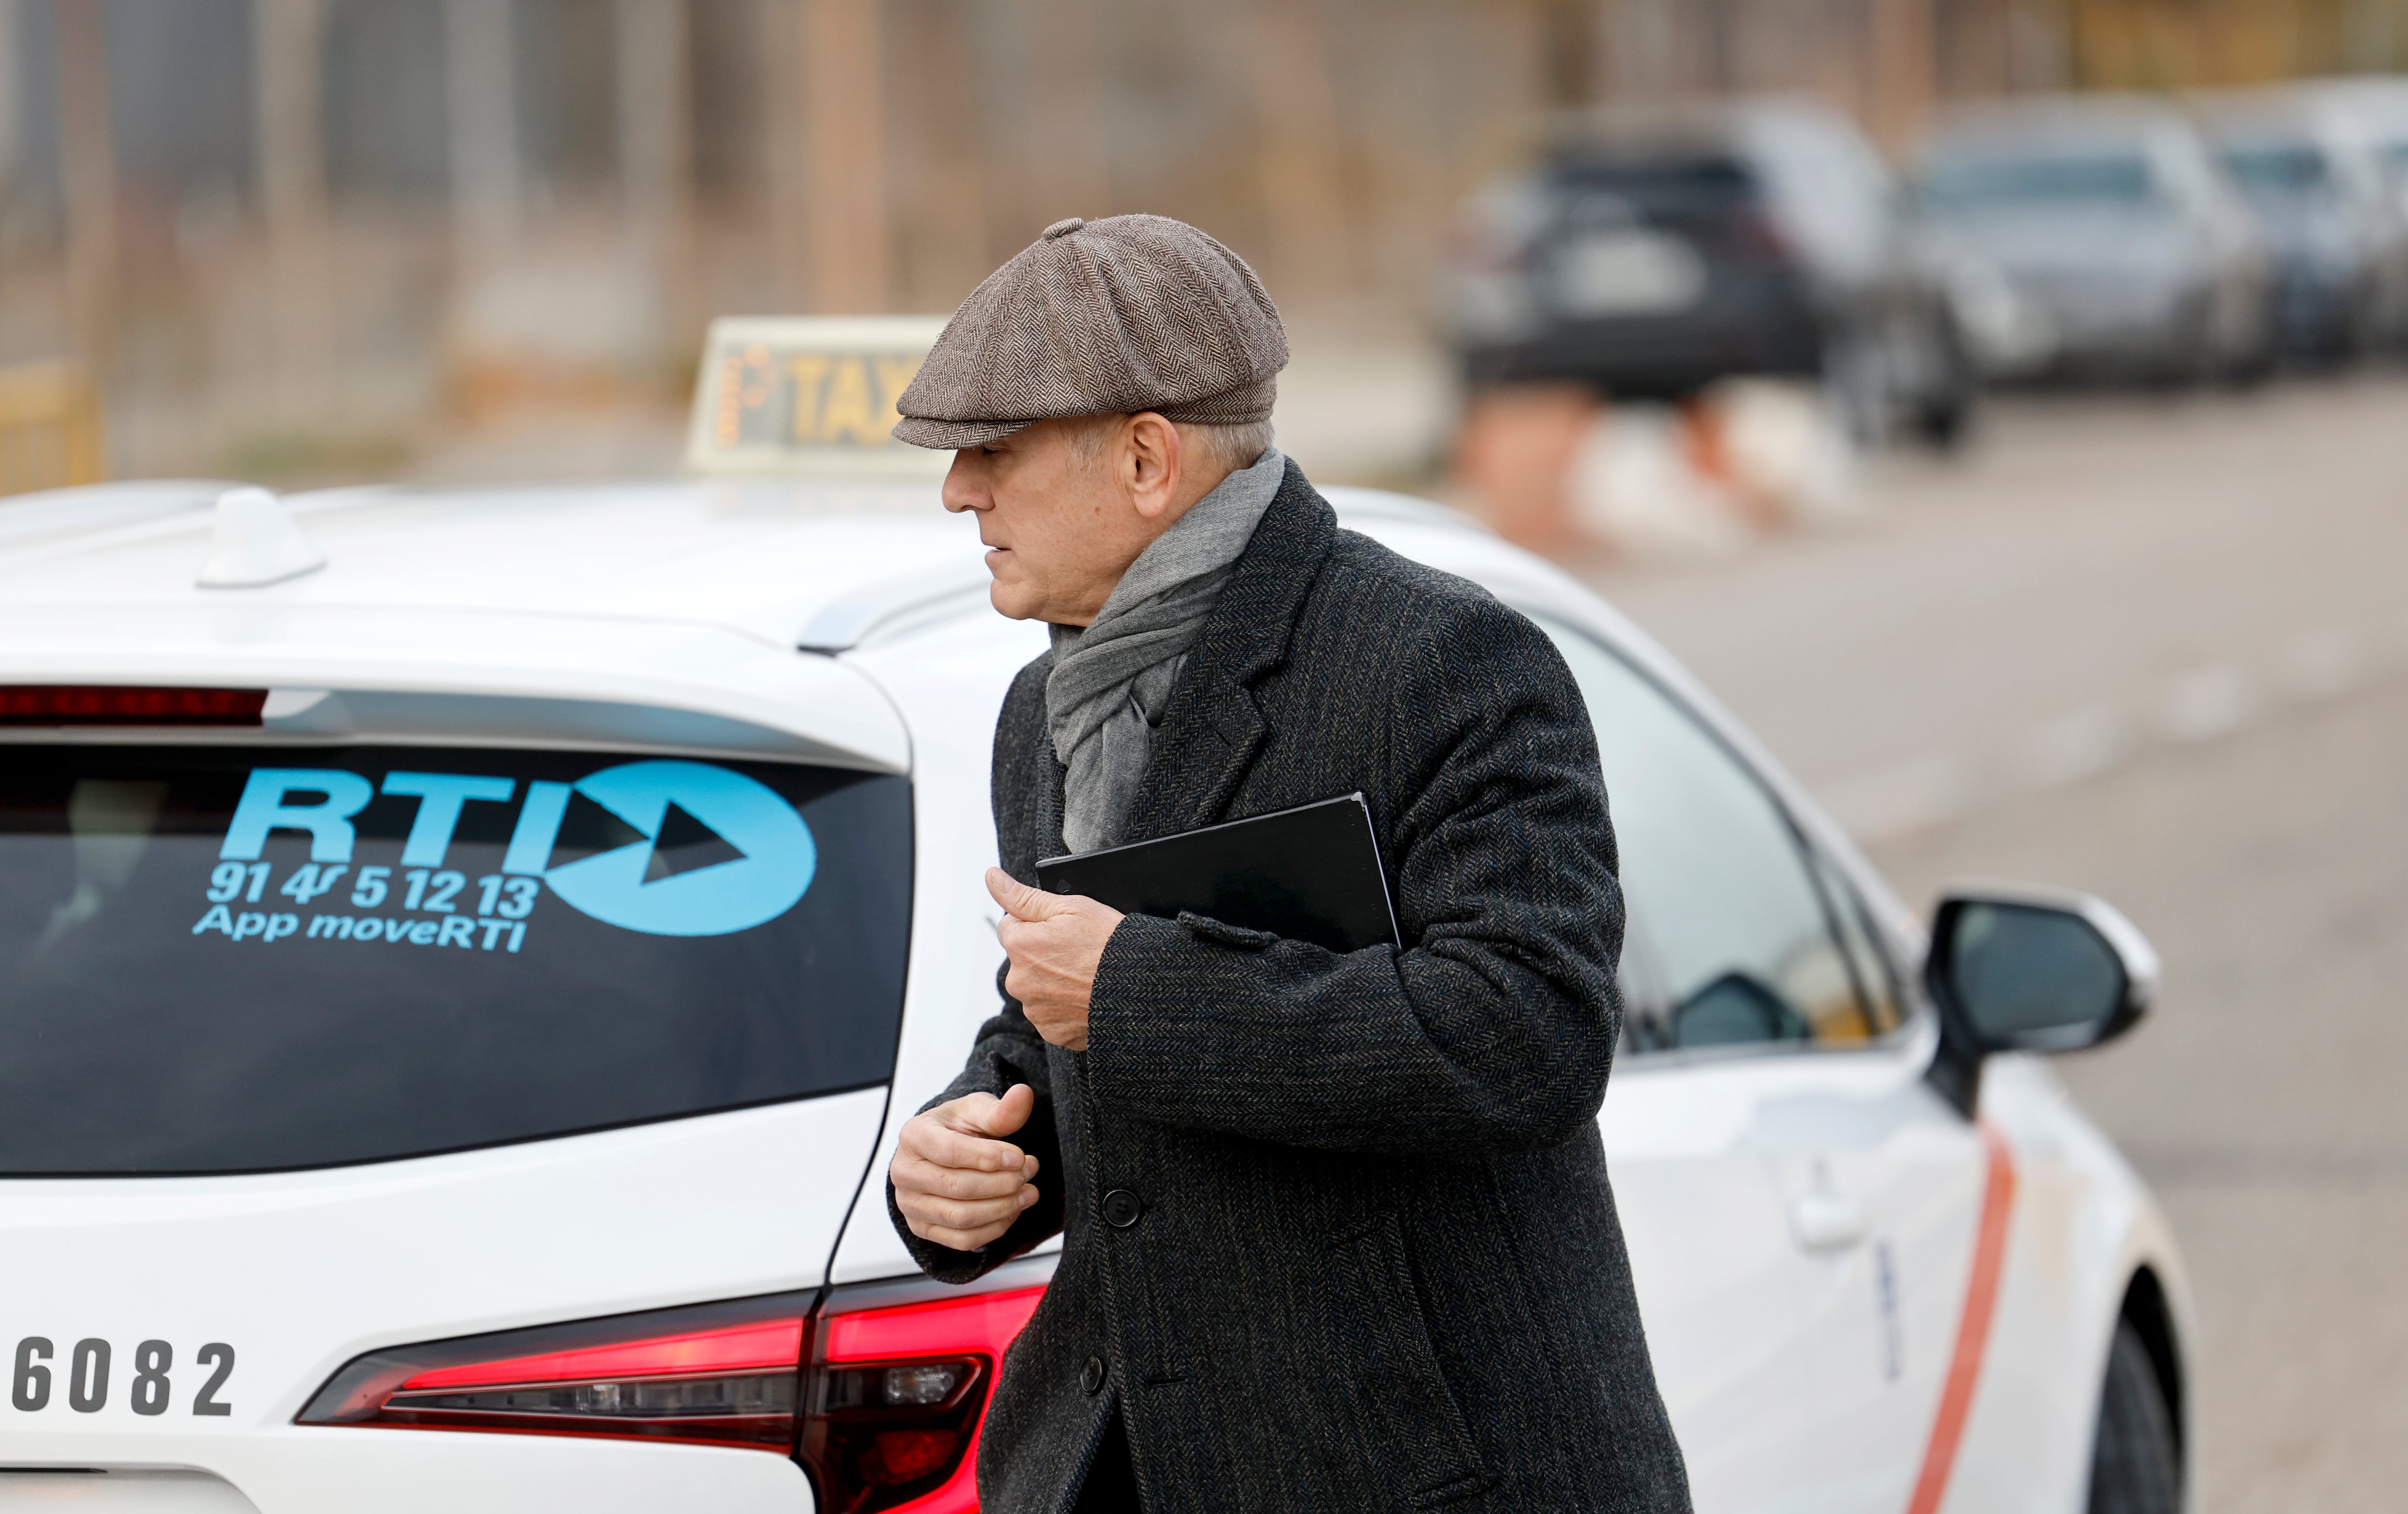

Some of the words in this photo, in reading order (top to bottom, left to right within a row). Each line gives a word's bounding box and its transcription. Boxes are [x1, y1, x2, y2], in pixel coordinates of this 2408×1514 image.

[219, 767, 573, 875] RTI
[206, 861, 273, 904] 91
[403, 868, 467, 913] 12
[477, 873, 540, 919] 13
[191, 903, 301, 943] App
[305, 914, 528, 953] moveRTI
[12, 1336, 235, 1416] 6082
